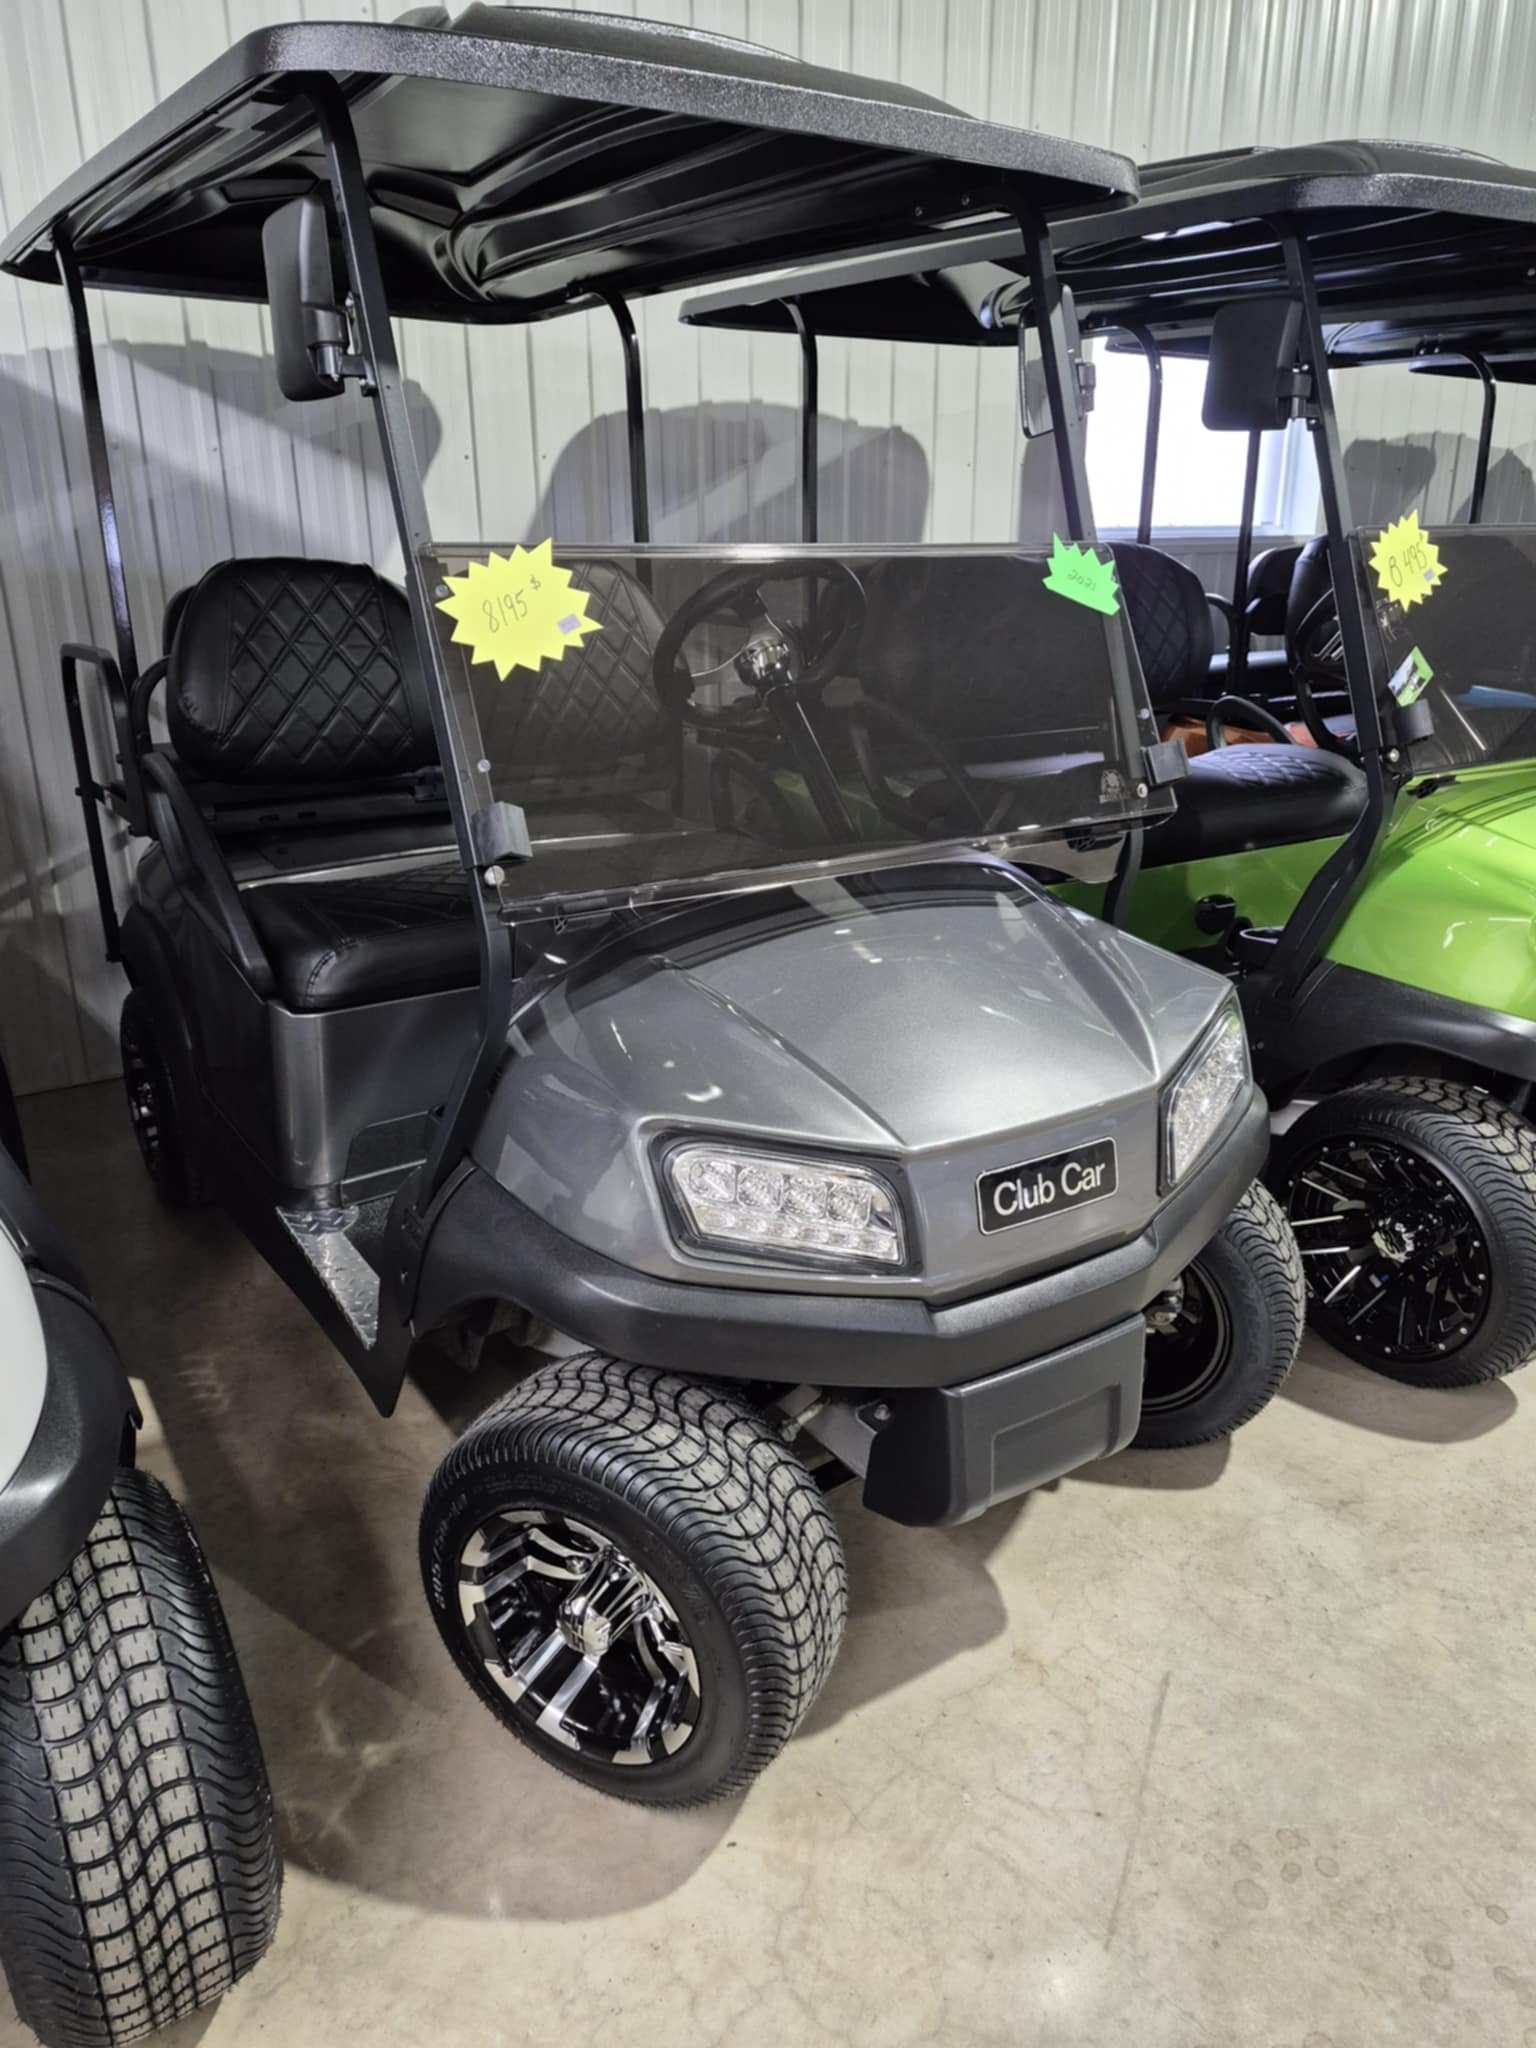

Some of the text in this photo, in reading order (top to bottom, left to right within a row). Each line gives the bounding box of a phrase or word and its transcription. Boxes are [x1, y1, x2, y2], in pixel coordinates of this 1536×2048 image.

[482, 590, 529, 633] 8195
[529, 575, 542, 591] $
[993, 1162, 1106, 1217] Club Car
